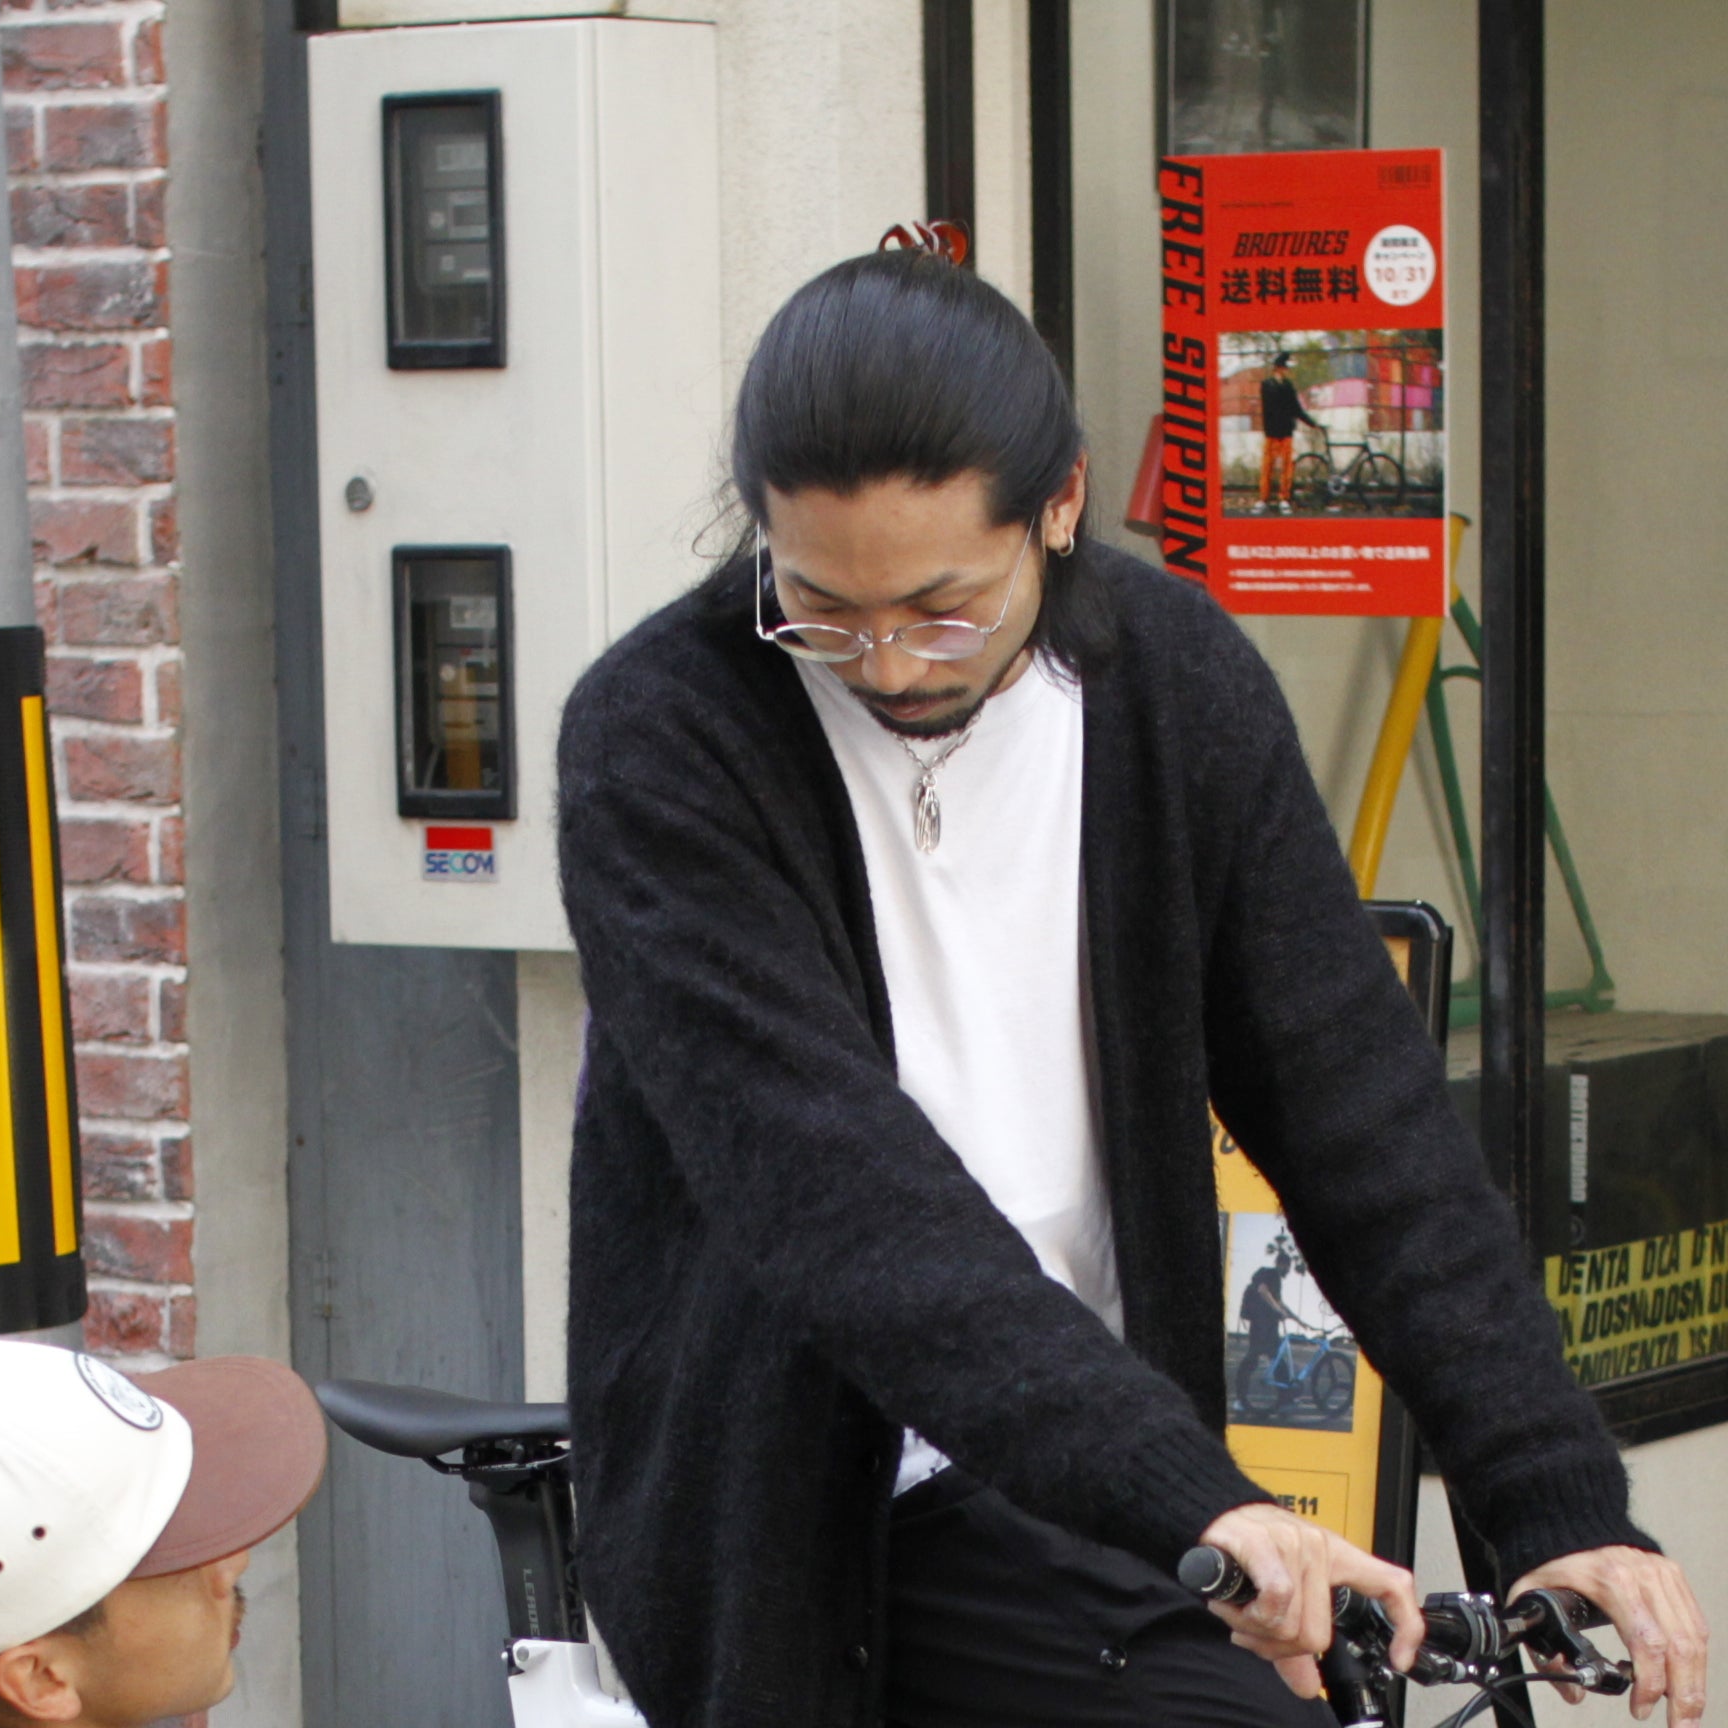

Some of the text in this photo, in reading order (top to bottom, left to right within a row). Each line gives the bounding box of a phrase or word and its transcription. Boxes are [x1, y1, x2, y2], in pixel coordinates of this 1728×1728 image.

[1233, 230, 1350, 258] BROTURES
[1221, 264, 1360, 305] 送料無料
[1160, 162, 1208, 587] FREE SHIPPIN
[425, 851, 494, 875] SECOM
